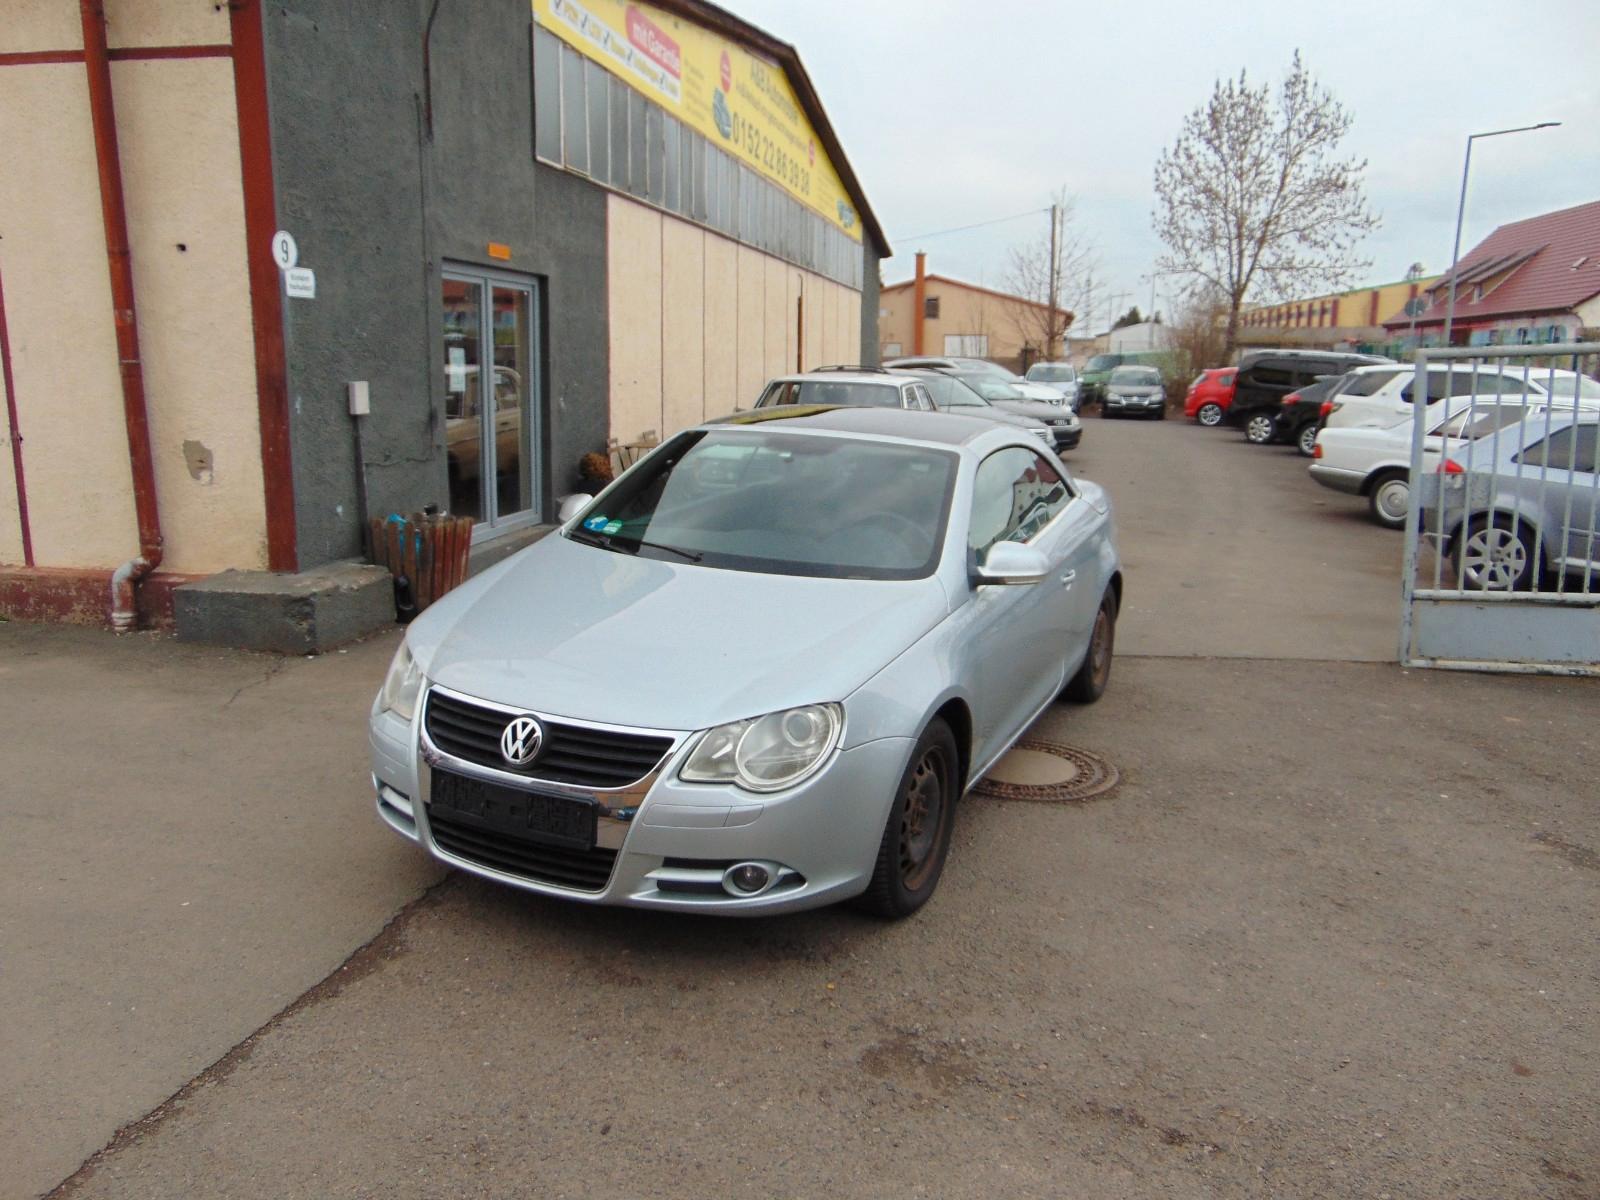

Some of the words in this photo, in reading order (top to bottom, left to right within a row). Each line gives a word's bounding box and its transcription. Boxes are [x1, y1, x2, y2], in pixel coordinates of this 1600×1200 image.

[733, 112, 760, 160] 0152
[281, 239, 289, 263] 9
[501, 717, 542, 764] VW
